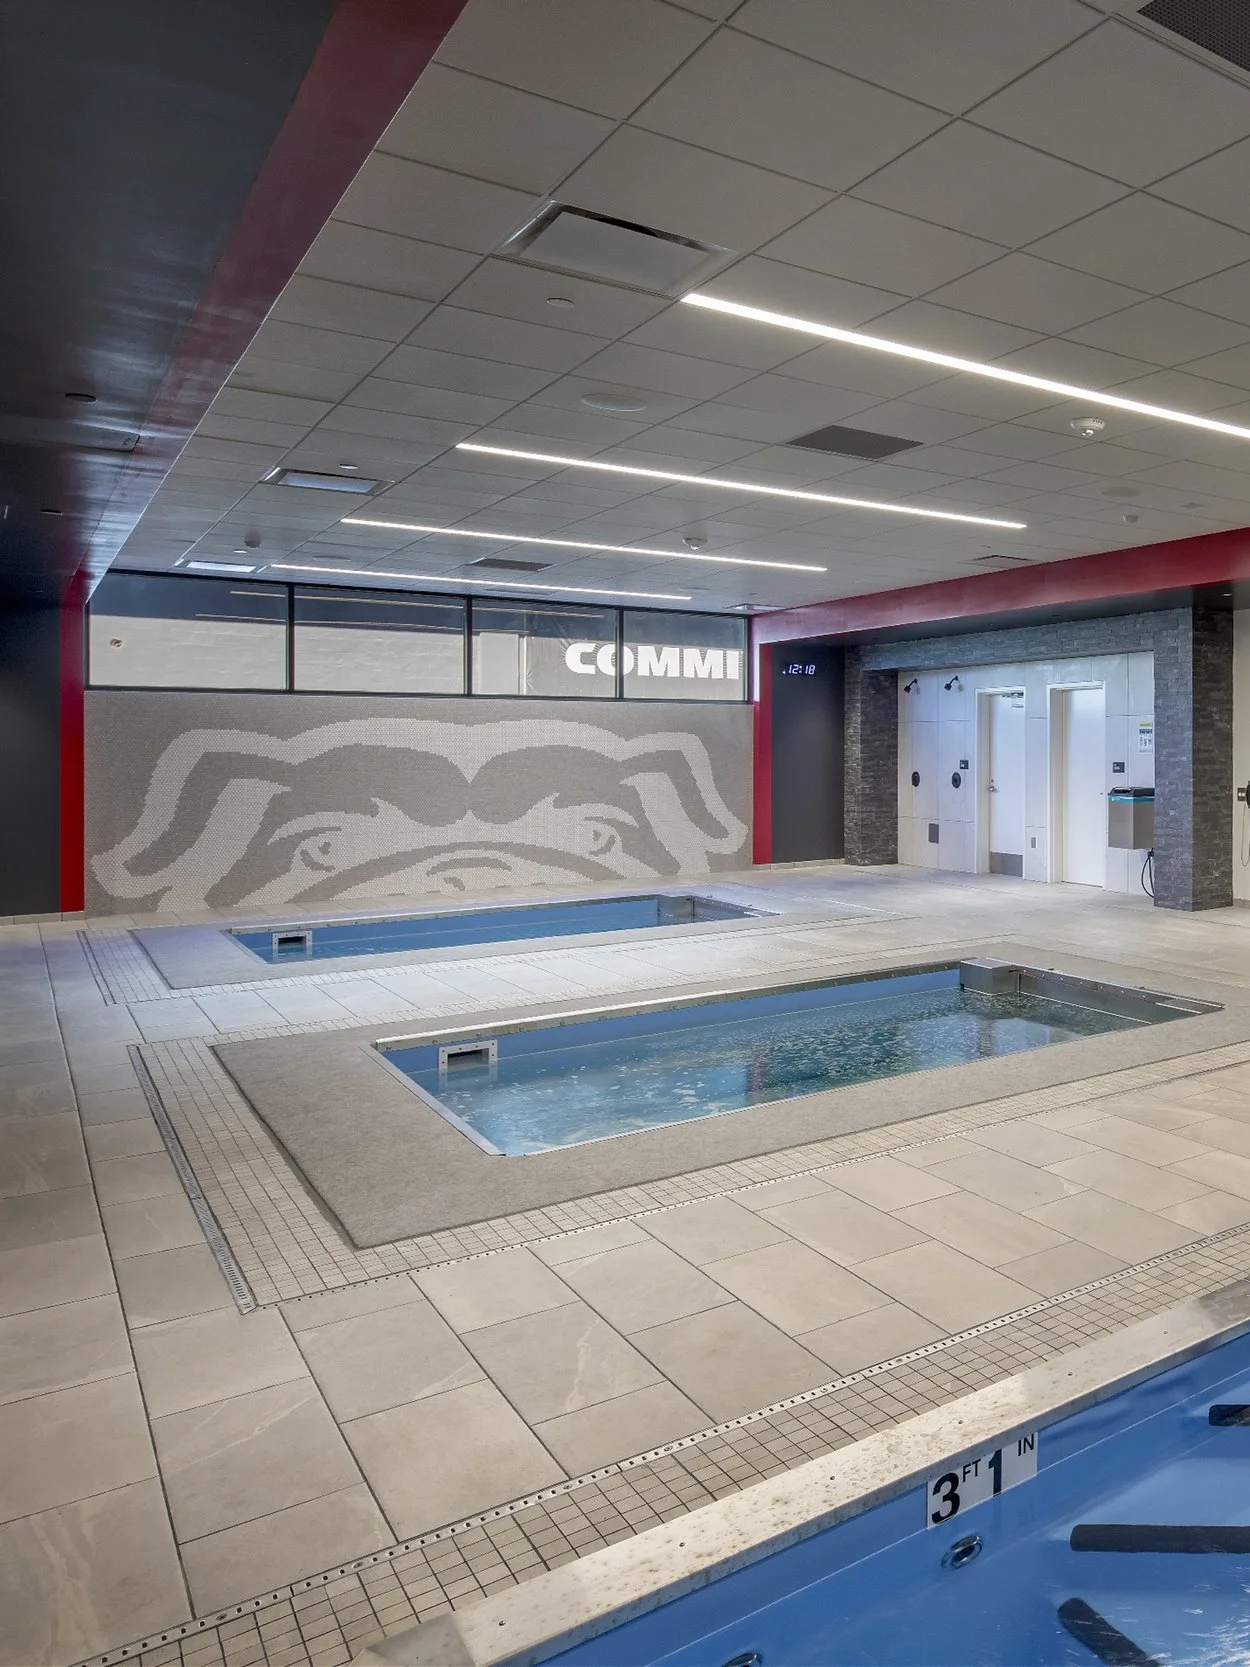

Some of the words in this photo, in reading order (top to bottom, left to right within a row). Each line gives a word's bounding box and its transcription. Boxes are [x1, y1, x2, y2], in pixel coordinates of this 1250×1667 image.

[565, 643, 740, 680] COMMI
[788, 664, 816, 675] 12:18
[931, 1472, 961, 1524] 3
[962, 1458, 981, 1482] FT
[988, 1448, 1003, 1498] 1
[1017, 1433, 1034, 1456] IN
